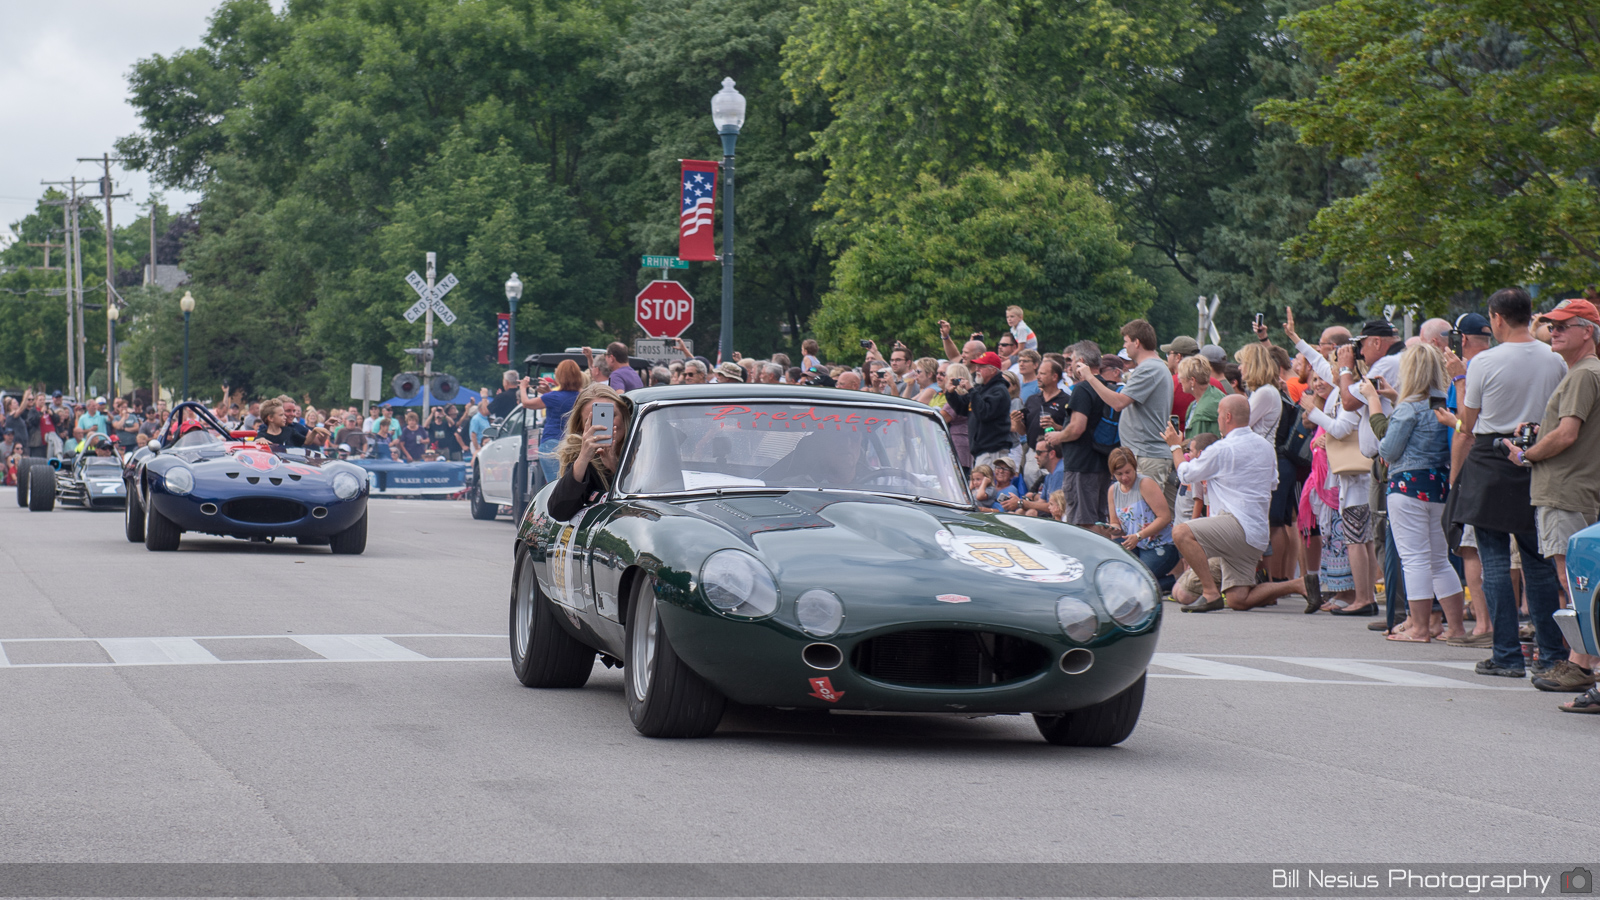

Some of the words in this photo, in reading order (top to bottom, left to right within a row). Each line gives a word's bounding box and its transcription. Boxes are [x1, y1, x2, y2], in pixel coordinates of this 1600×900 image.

[646, 257, 675, 267] RHINE
[407, 276, 456, 320] CROSSING
[640, 299, 689, 320] STOP
[638, 345, 661, 354] CROSS
[705, 405, 899, 426] Predator
[95, 482, 122, 494] 7
[815, 681, 835, 699] TOW
